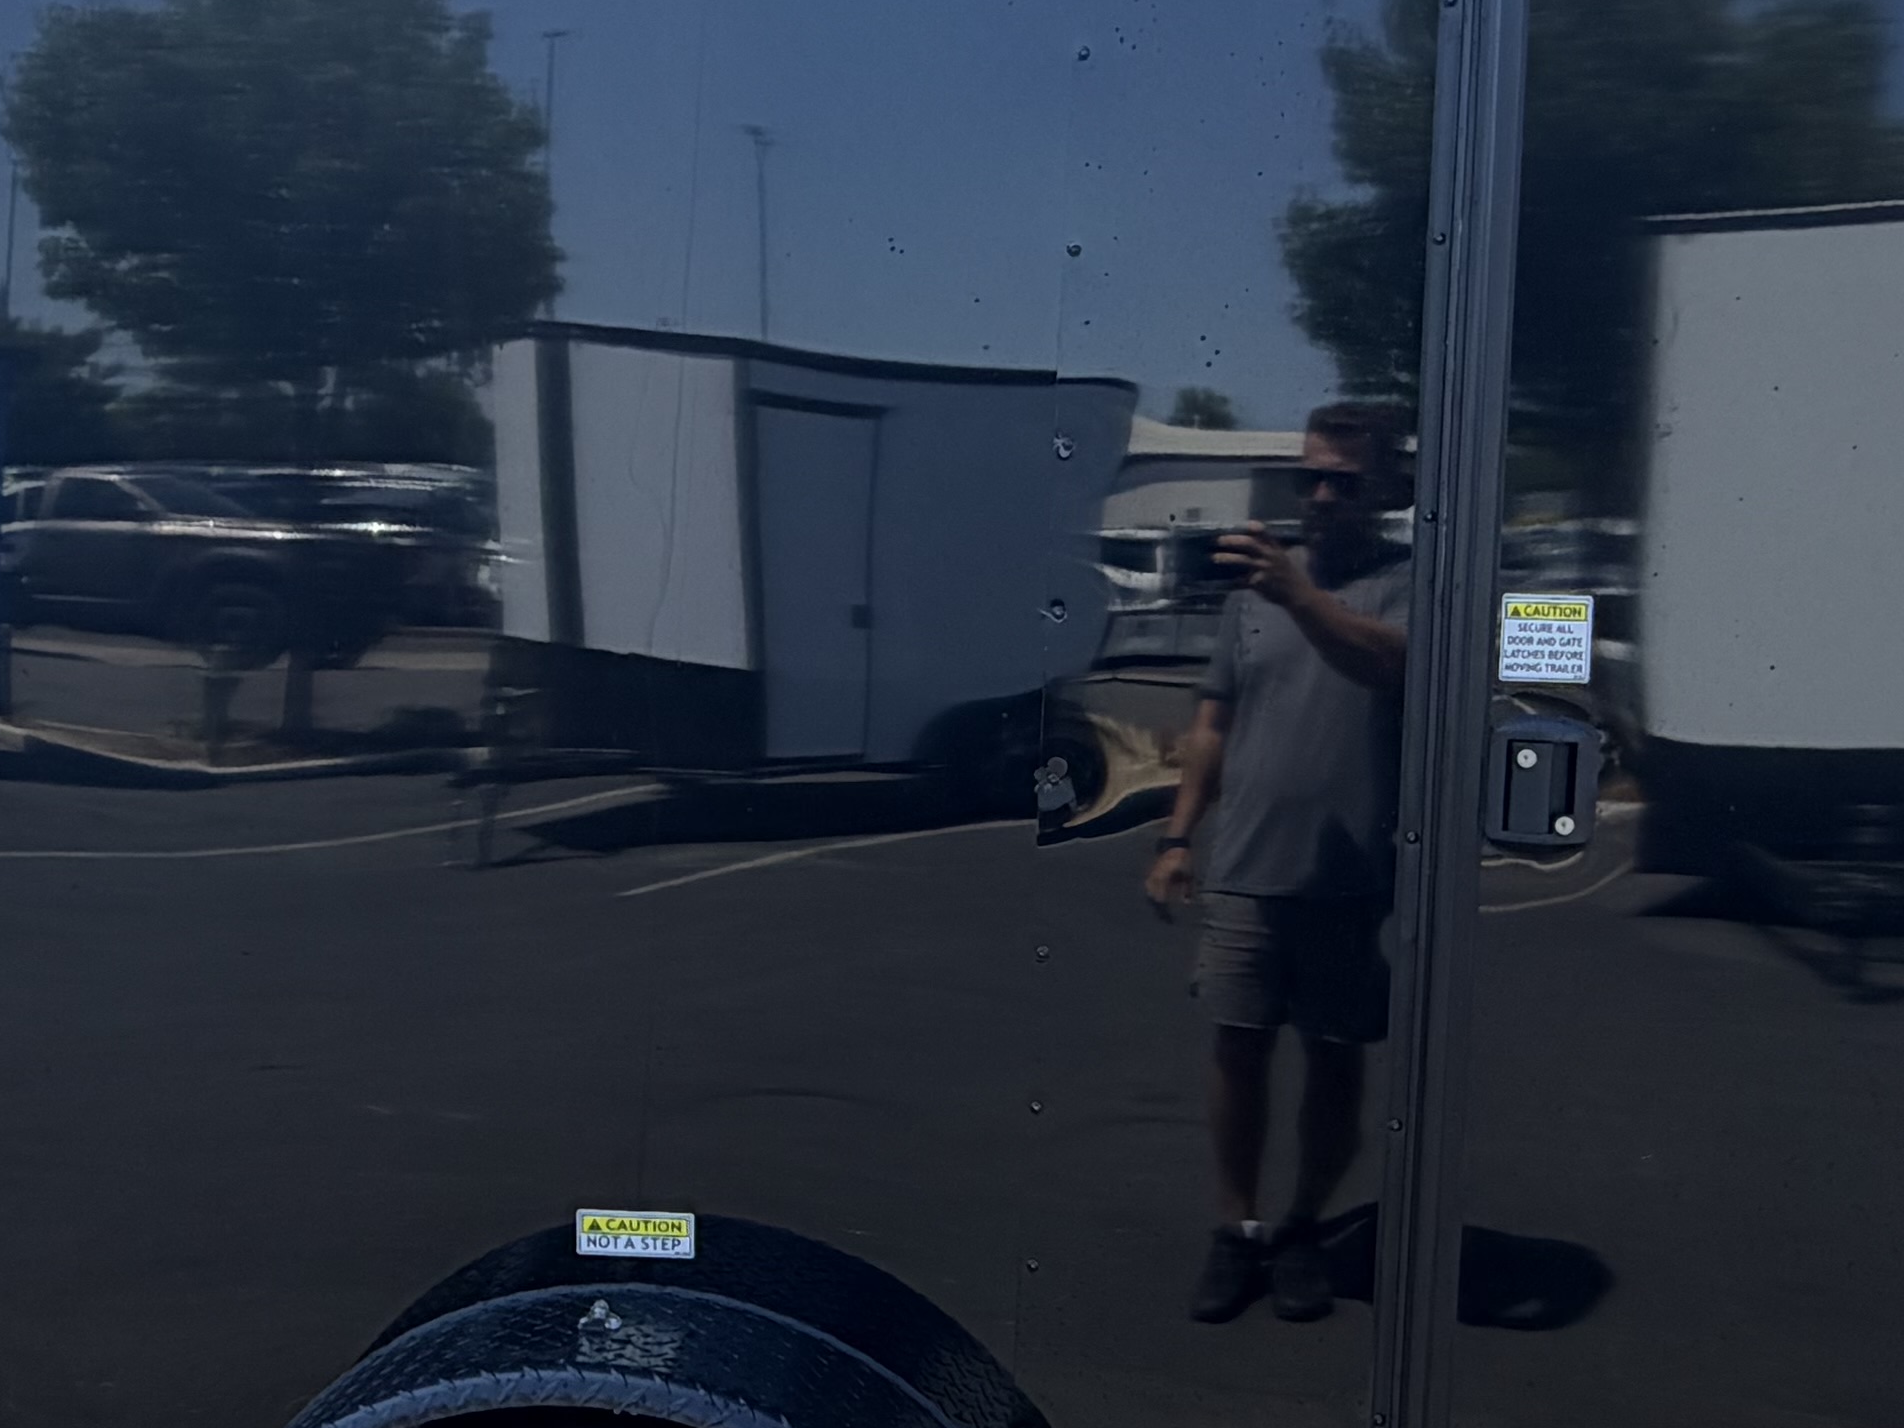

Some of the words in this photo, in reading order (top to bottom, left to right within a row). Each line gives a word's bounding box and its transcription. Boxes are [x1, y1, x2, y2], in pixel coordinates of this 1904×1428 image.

[1523, 604, 1583, 618] CAUTION
[1517, 623, 1553, 634] SECURE
[1556, 624, 1574, 634] ALL
[1537, 636, 1557, 647] AND
[1559, 637, 1583, 648] GATE
[605, 1218, 682, 1233] CAUTION
[586, 1235, 621, 1250] NOT
[623, 1236, 636, 1250] A
[641, 1236, 682, 1251] STEP
